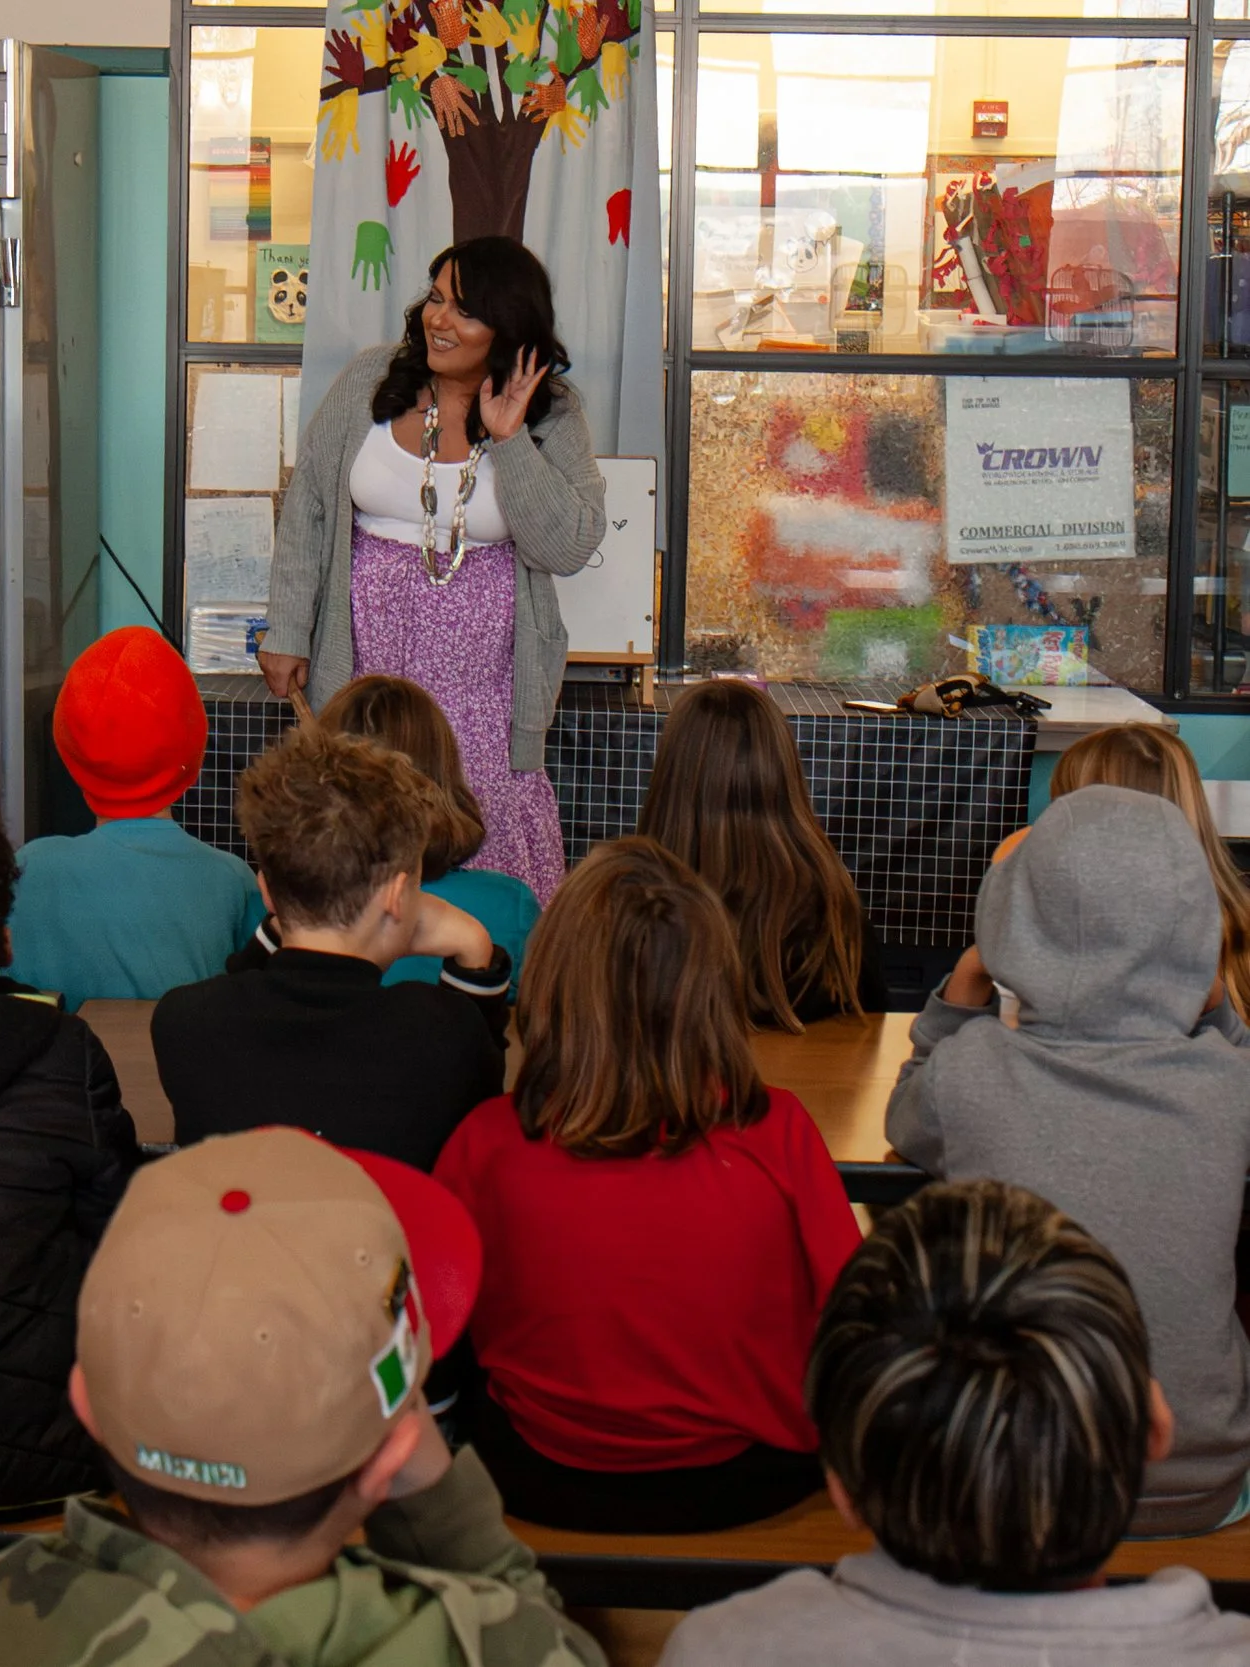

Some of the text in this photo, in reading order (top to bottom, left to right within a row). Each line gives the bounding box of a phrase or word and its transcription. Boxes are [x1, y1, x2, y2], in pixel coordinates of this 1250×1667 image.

[259, 248, 310, 268] Thank yo
[981, 445, 1103, 471] CROWN
[959, 520, 1126, 539] COMMERCIAL DIVISION
[136, 1444, 247, 1489] MEXICO
